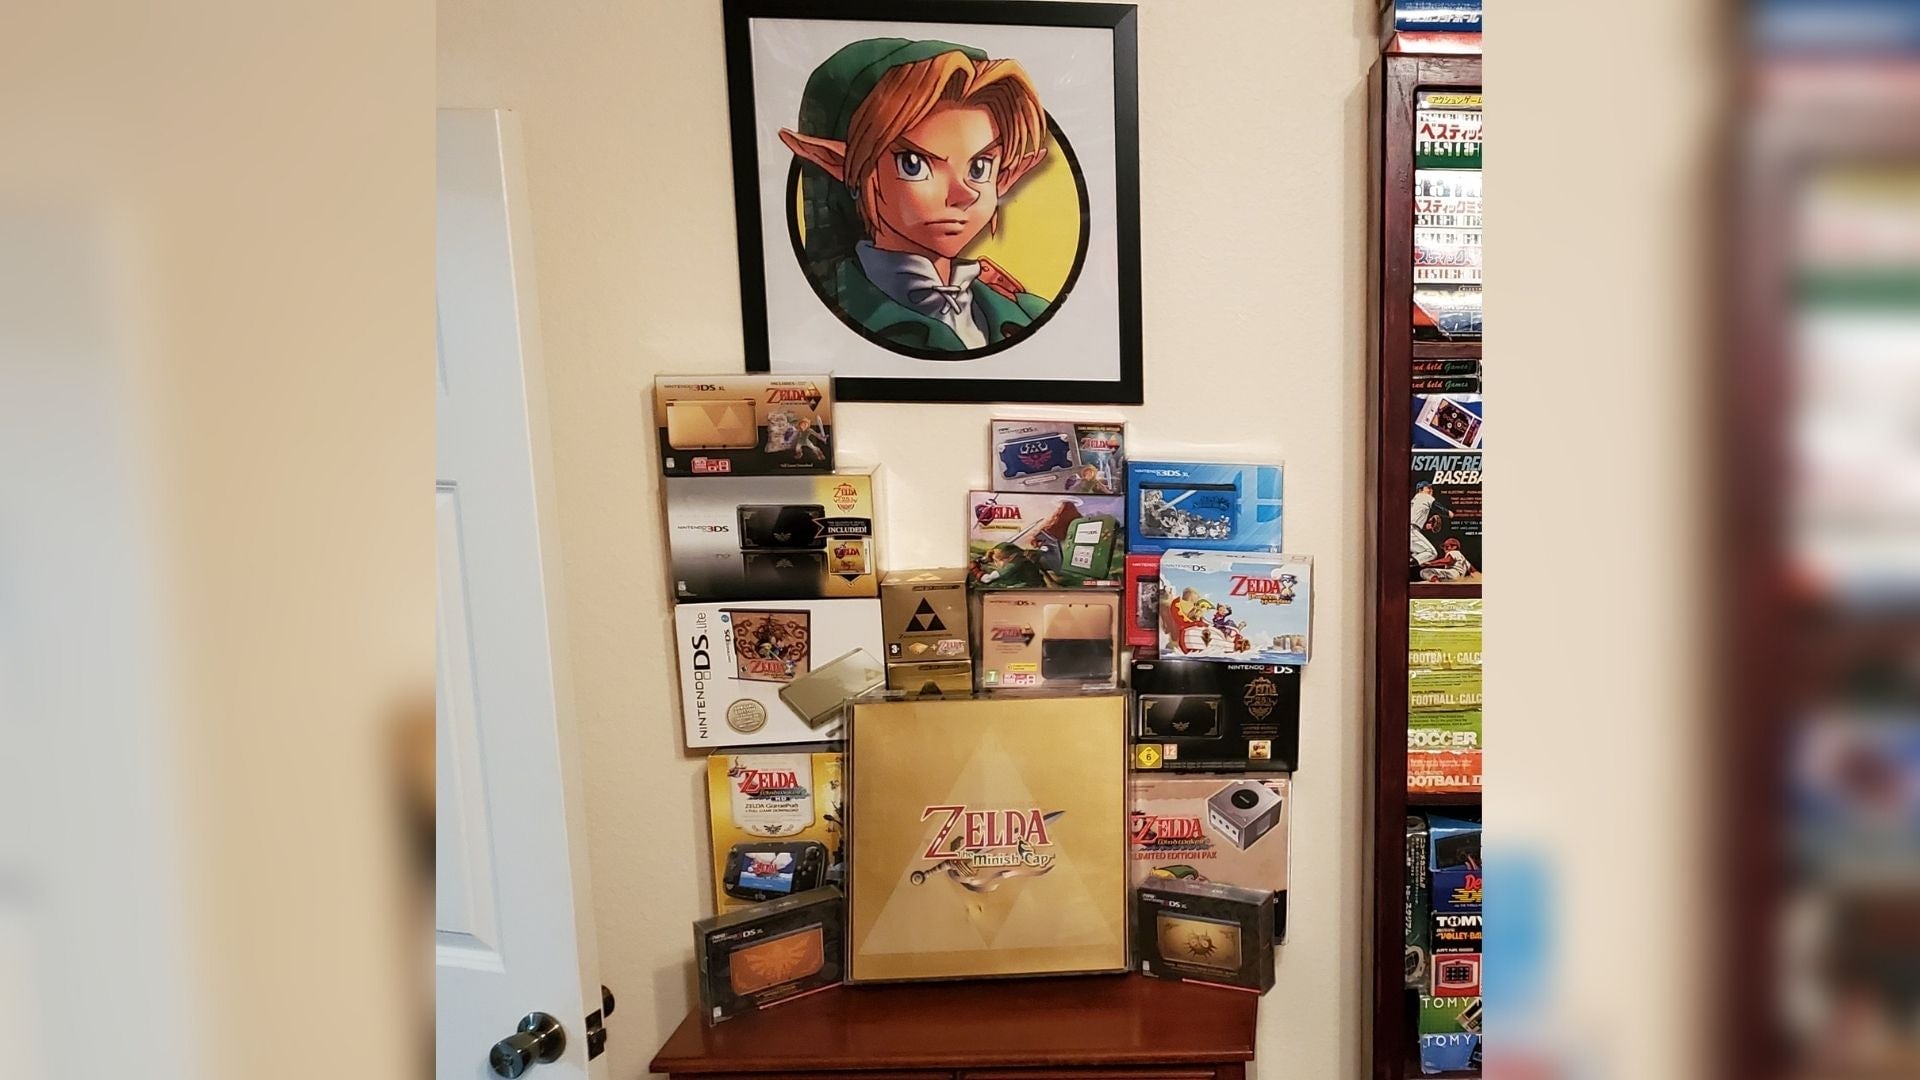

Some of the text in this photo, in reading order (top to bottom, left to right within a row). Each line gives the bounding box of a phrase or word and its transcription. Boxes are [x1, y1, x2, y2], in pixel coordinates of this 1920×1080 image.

[1445, 381, 1468, 391] Games
[765, 387, 807, 404] ZELDA
[978, 504, 1022, 520] ZELDA
[828, 526, 867, 534] INCLUDED!
[1230, 575, 1281, 596] ZELDA
[691, 634, 711, 670] DS
[1264, 665, 1294, 675] 3DS
[695, 671, 709, 739] NINTENDO
[1408, 730, 1478, 747] SOCCER
[1146, 753, 1152, 761] 6
[740, 769, 799, 793] ZELDA
[1408, 774, 1470, 788] OOTBALL
[920, 804, 1054, 860] ZELDA
[1133, 815, 1204, 844] ZELDA
[1023, 852, 1056, 868] Cap
[1135, 852, 1167, 860] LIMITED
[1167, 852, 1200, 860] EDITION
